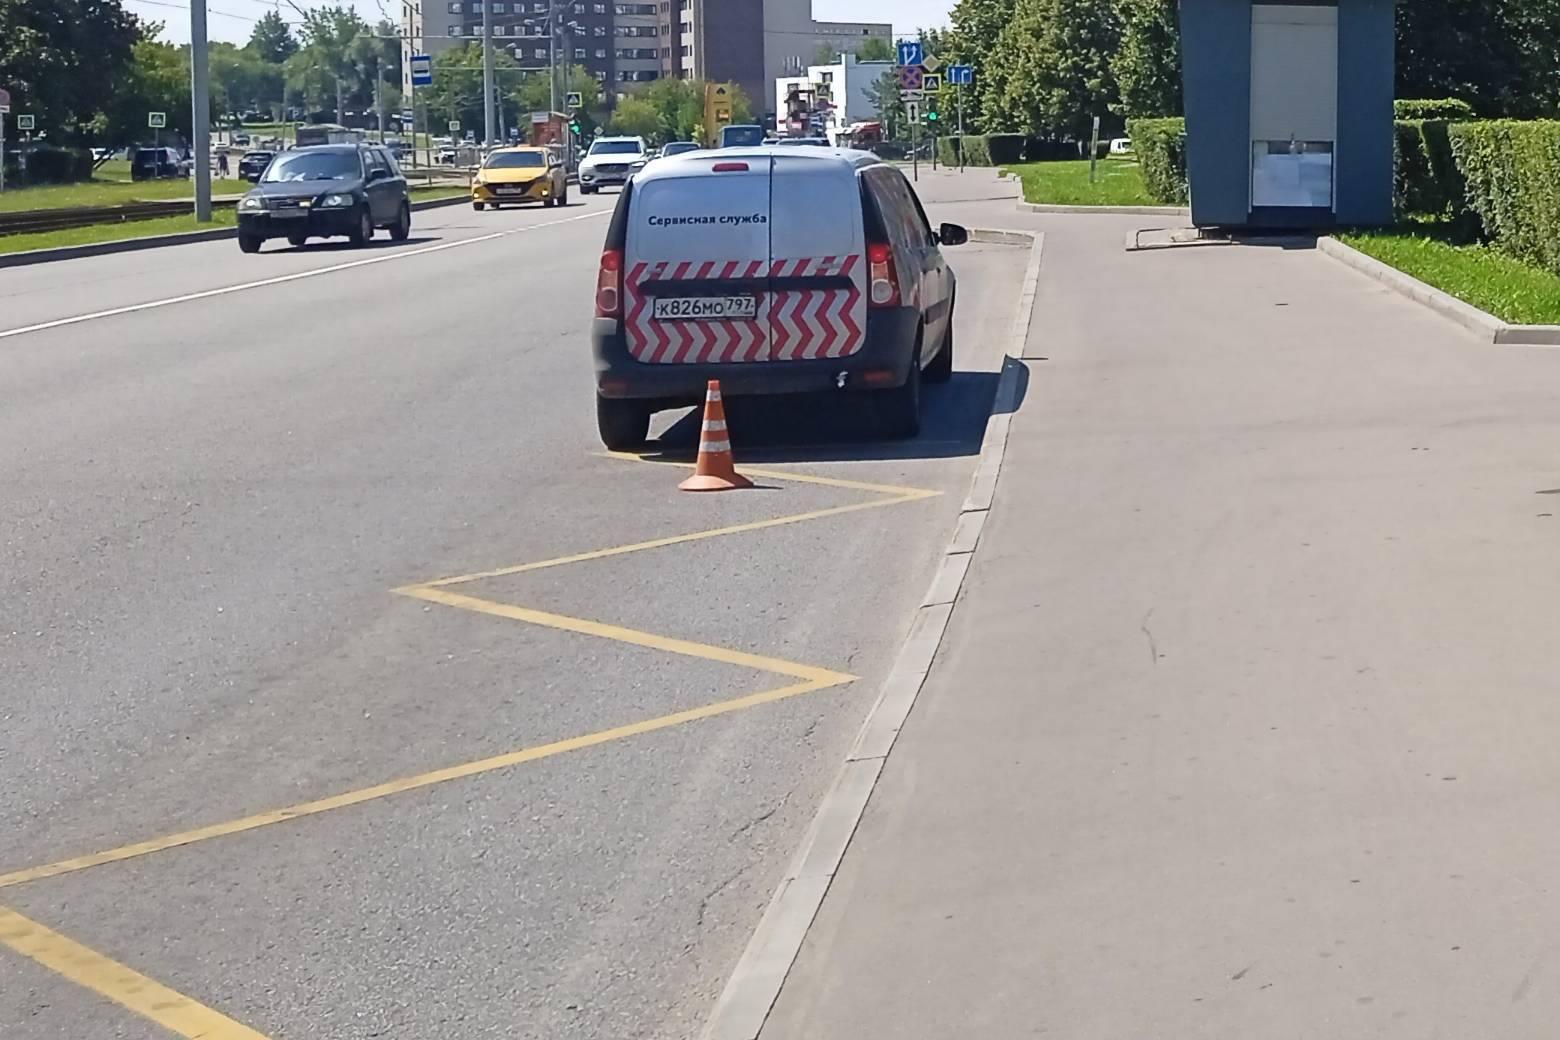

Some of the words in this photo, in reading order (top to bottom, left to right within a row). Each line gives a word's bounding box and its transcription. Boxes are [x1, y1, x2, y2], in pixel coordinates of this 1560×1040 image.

[648, 215, 716, 227] Сервисная
[719, 213, 767, 227] служба
[727, 298, 752, 310] 797
